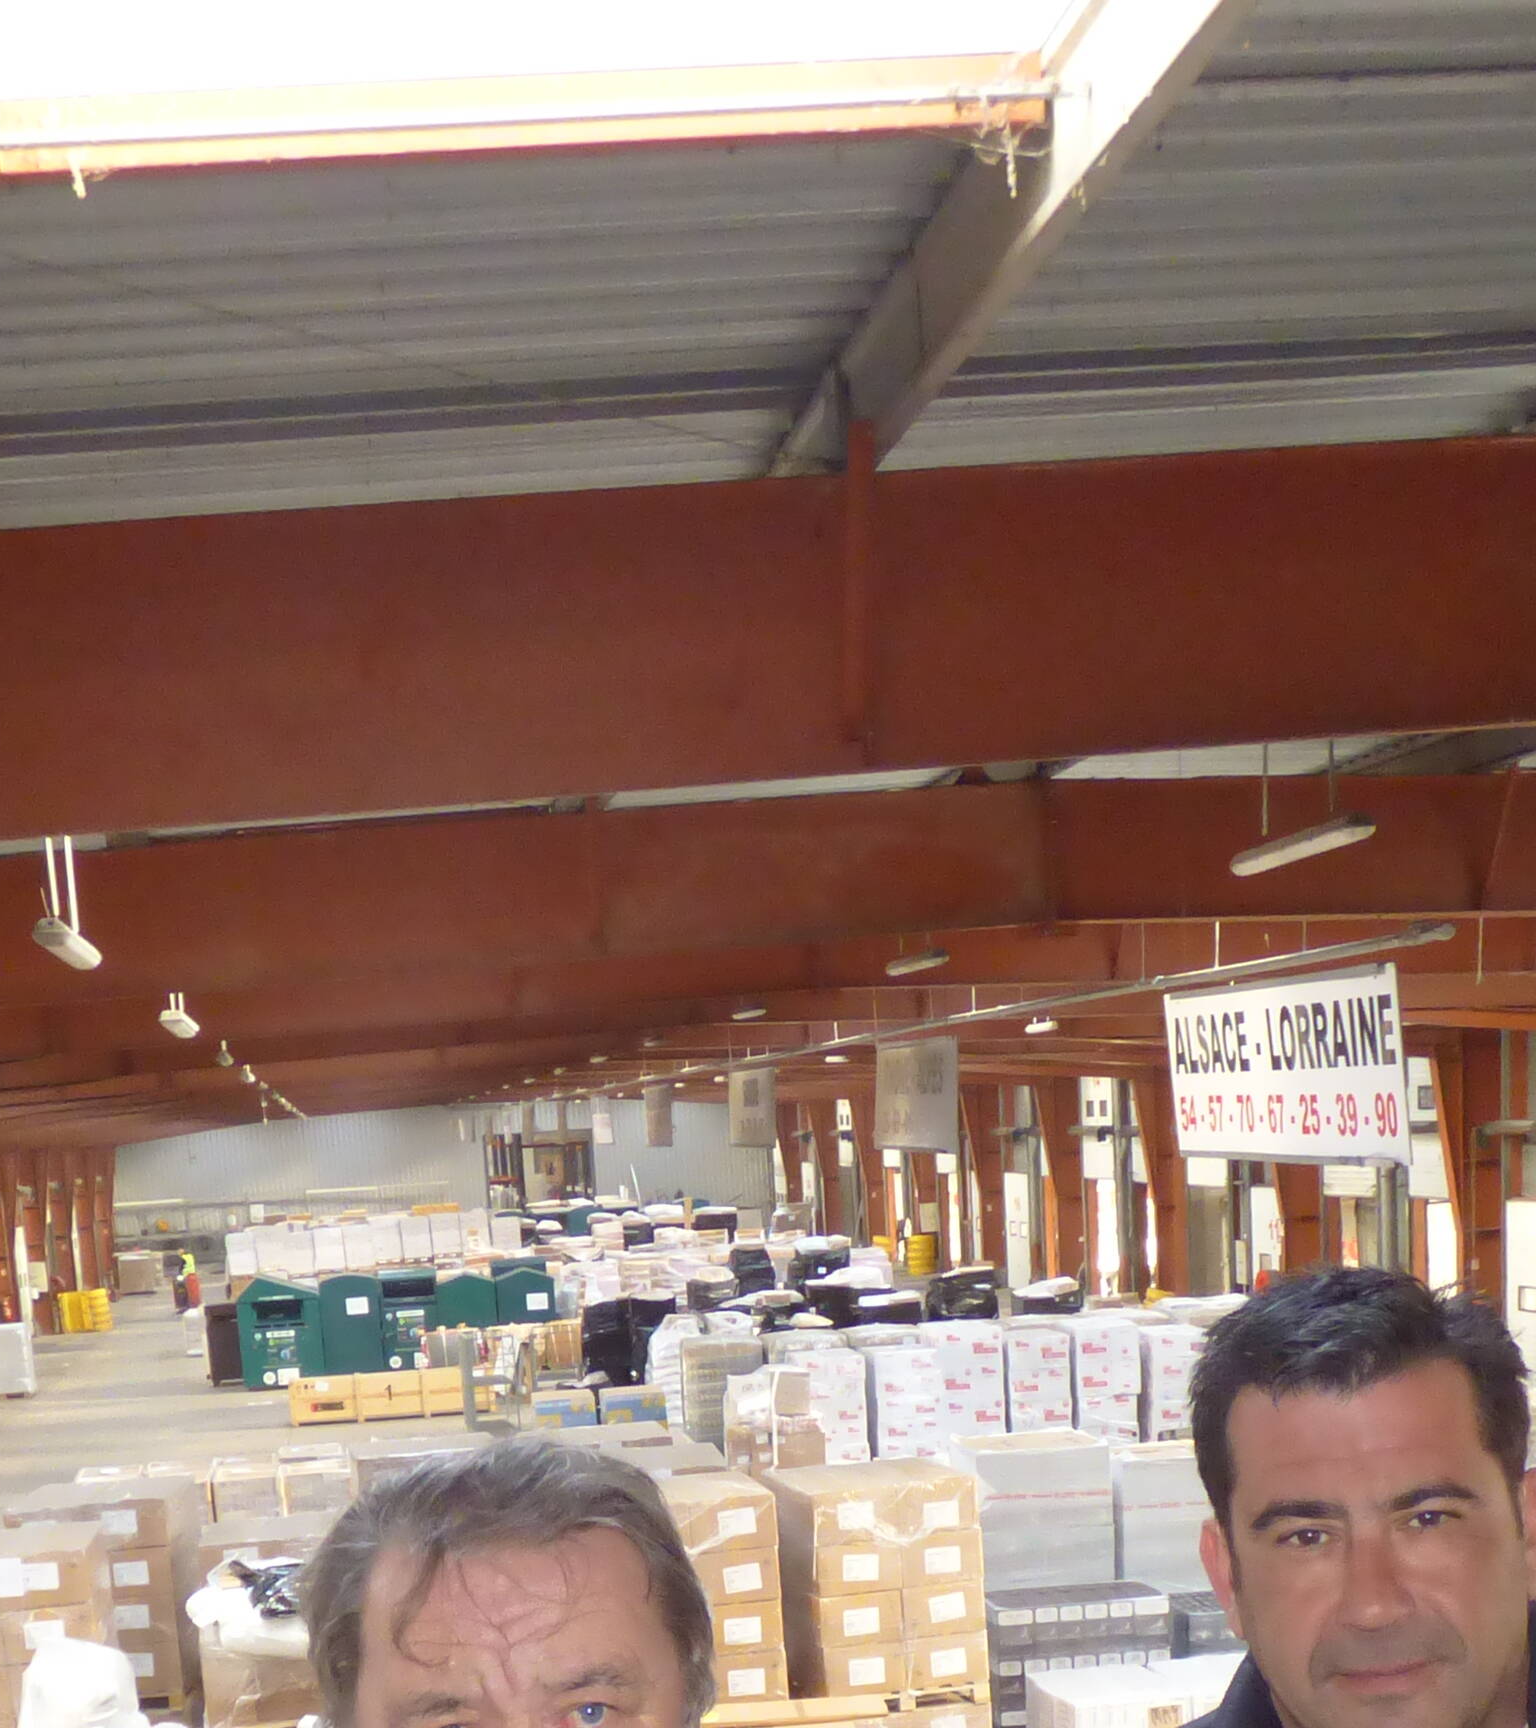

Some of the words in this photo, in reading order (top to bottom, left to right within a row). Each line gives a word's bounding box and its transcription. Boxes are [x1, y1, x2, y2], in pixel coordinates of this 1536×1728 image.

[1174, 1011, 1250, 1075] ALSACE
[1265, 994, 1397, 1072] LORRAINE
[1180, 1095, 1198, 1132] 54
[1208, 1095, 1224, 1132] 57
[1236, 1094, 1255, 1133] 70
[1267, 1094, 1285, 1134] 67
[1299, 1093, 1322, 1136] 25
[1335, 1093, 1359, 1137] 39
[1374, 1092, 1399, 1138] 90
